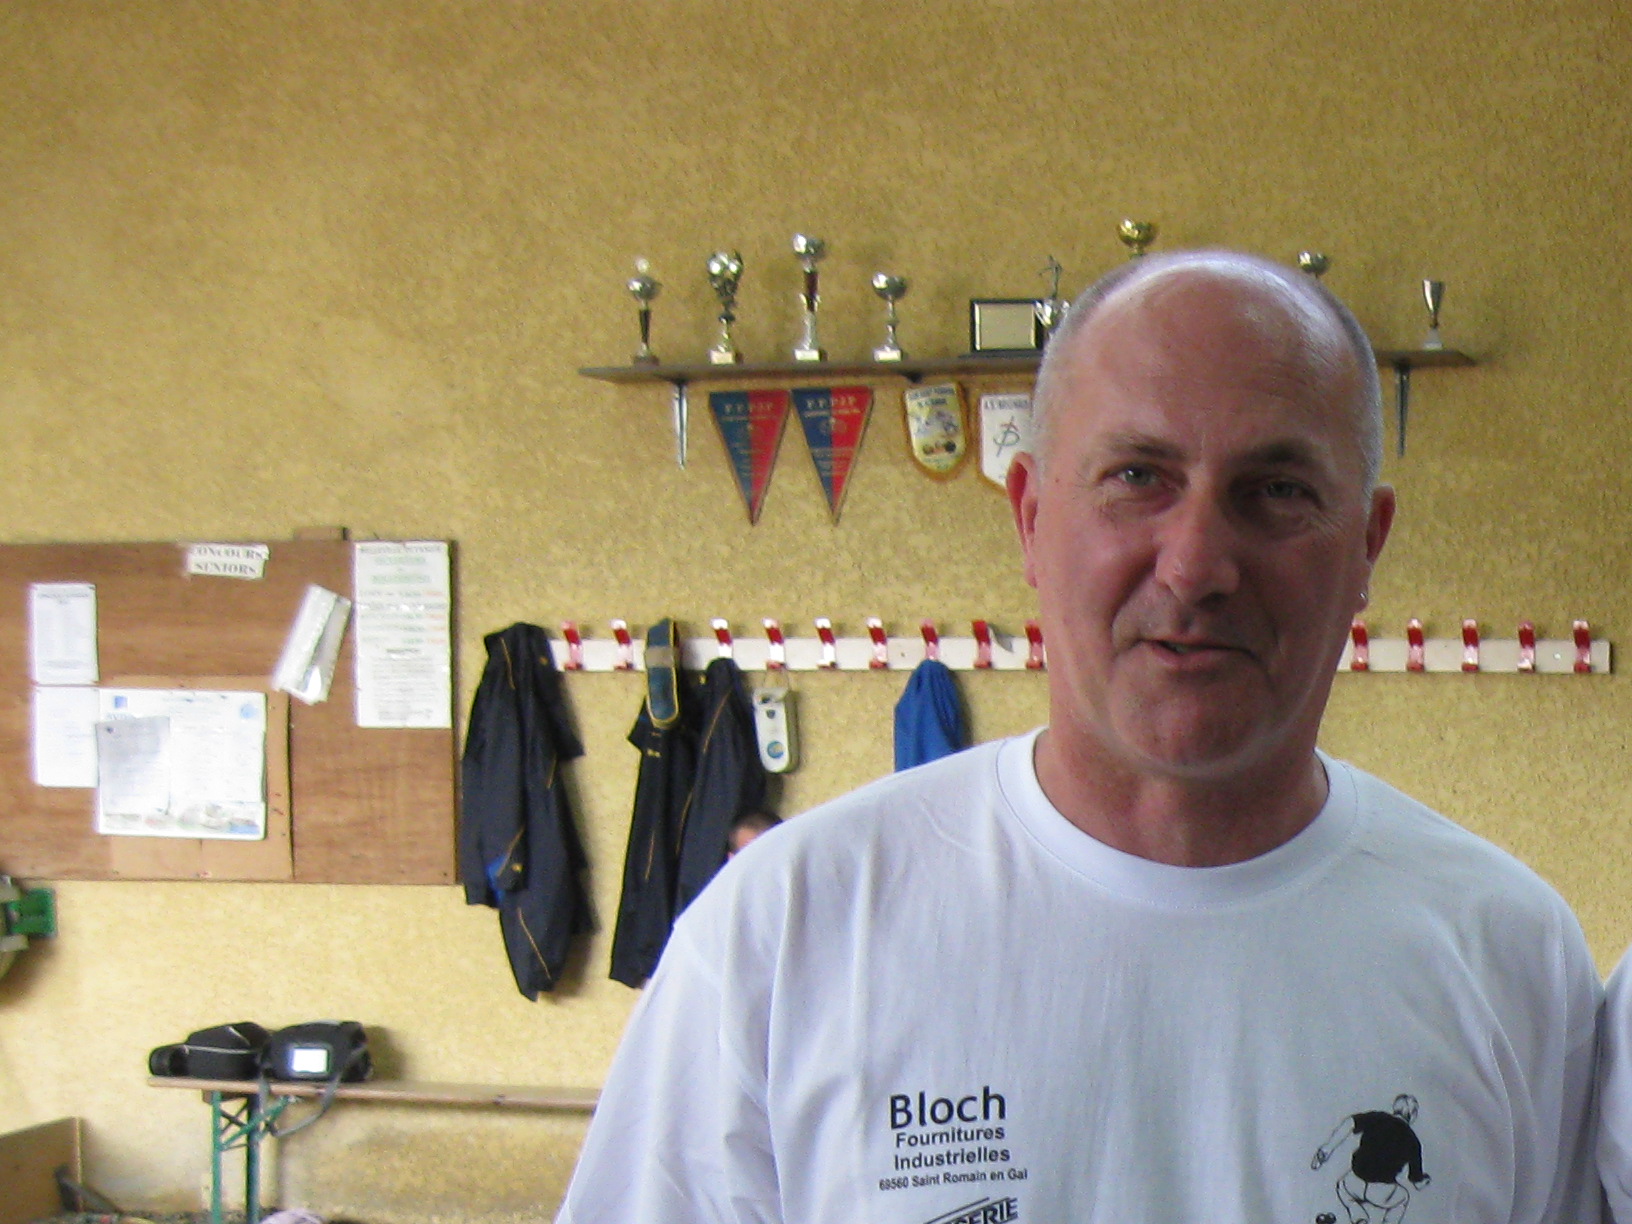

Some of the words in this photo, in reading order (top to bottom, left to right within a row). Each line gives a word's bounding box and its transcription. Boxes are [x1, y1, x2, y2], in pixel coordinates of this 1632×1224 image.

[890, 1085, 1007, 1130] Bloch
[895, 1127, 1005, 1148] Fournitures
[894, 1147, 1011, 1171] Industrielles
[912, 1174, 940, 1187] Saint
[943, 1170, 987, 1183] Romain
[990, 1170, 1004, 1181] en
[1007, 1168, 1028, 1180] Gal
